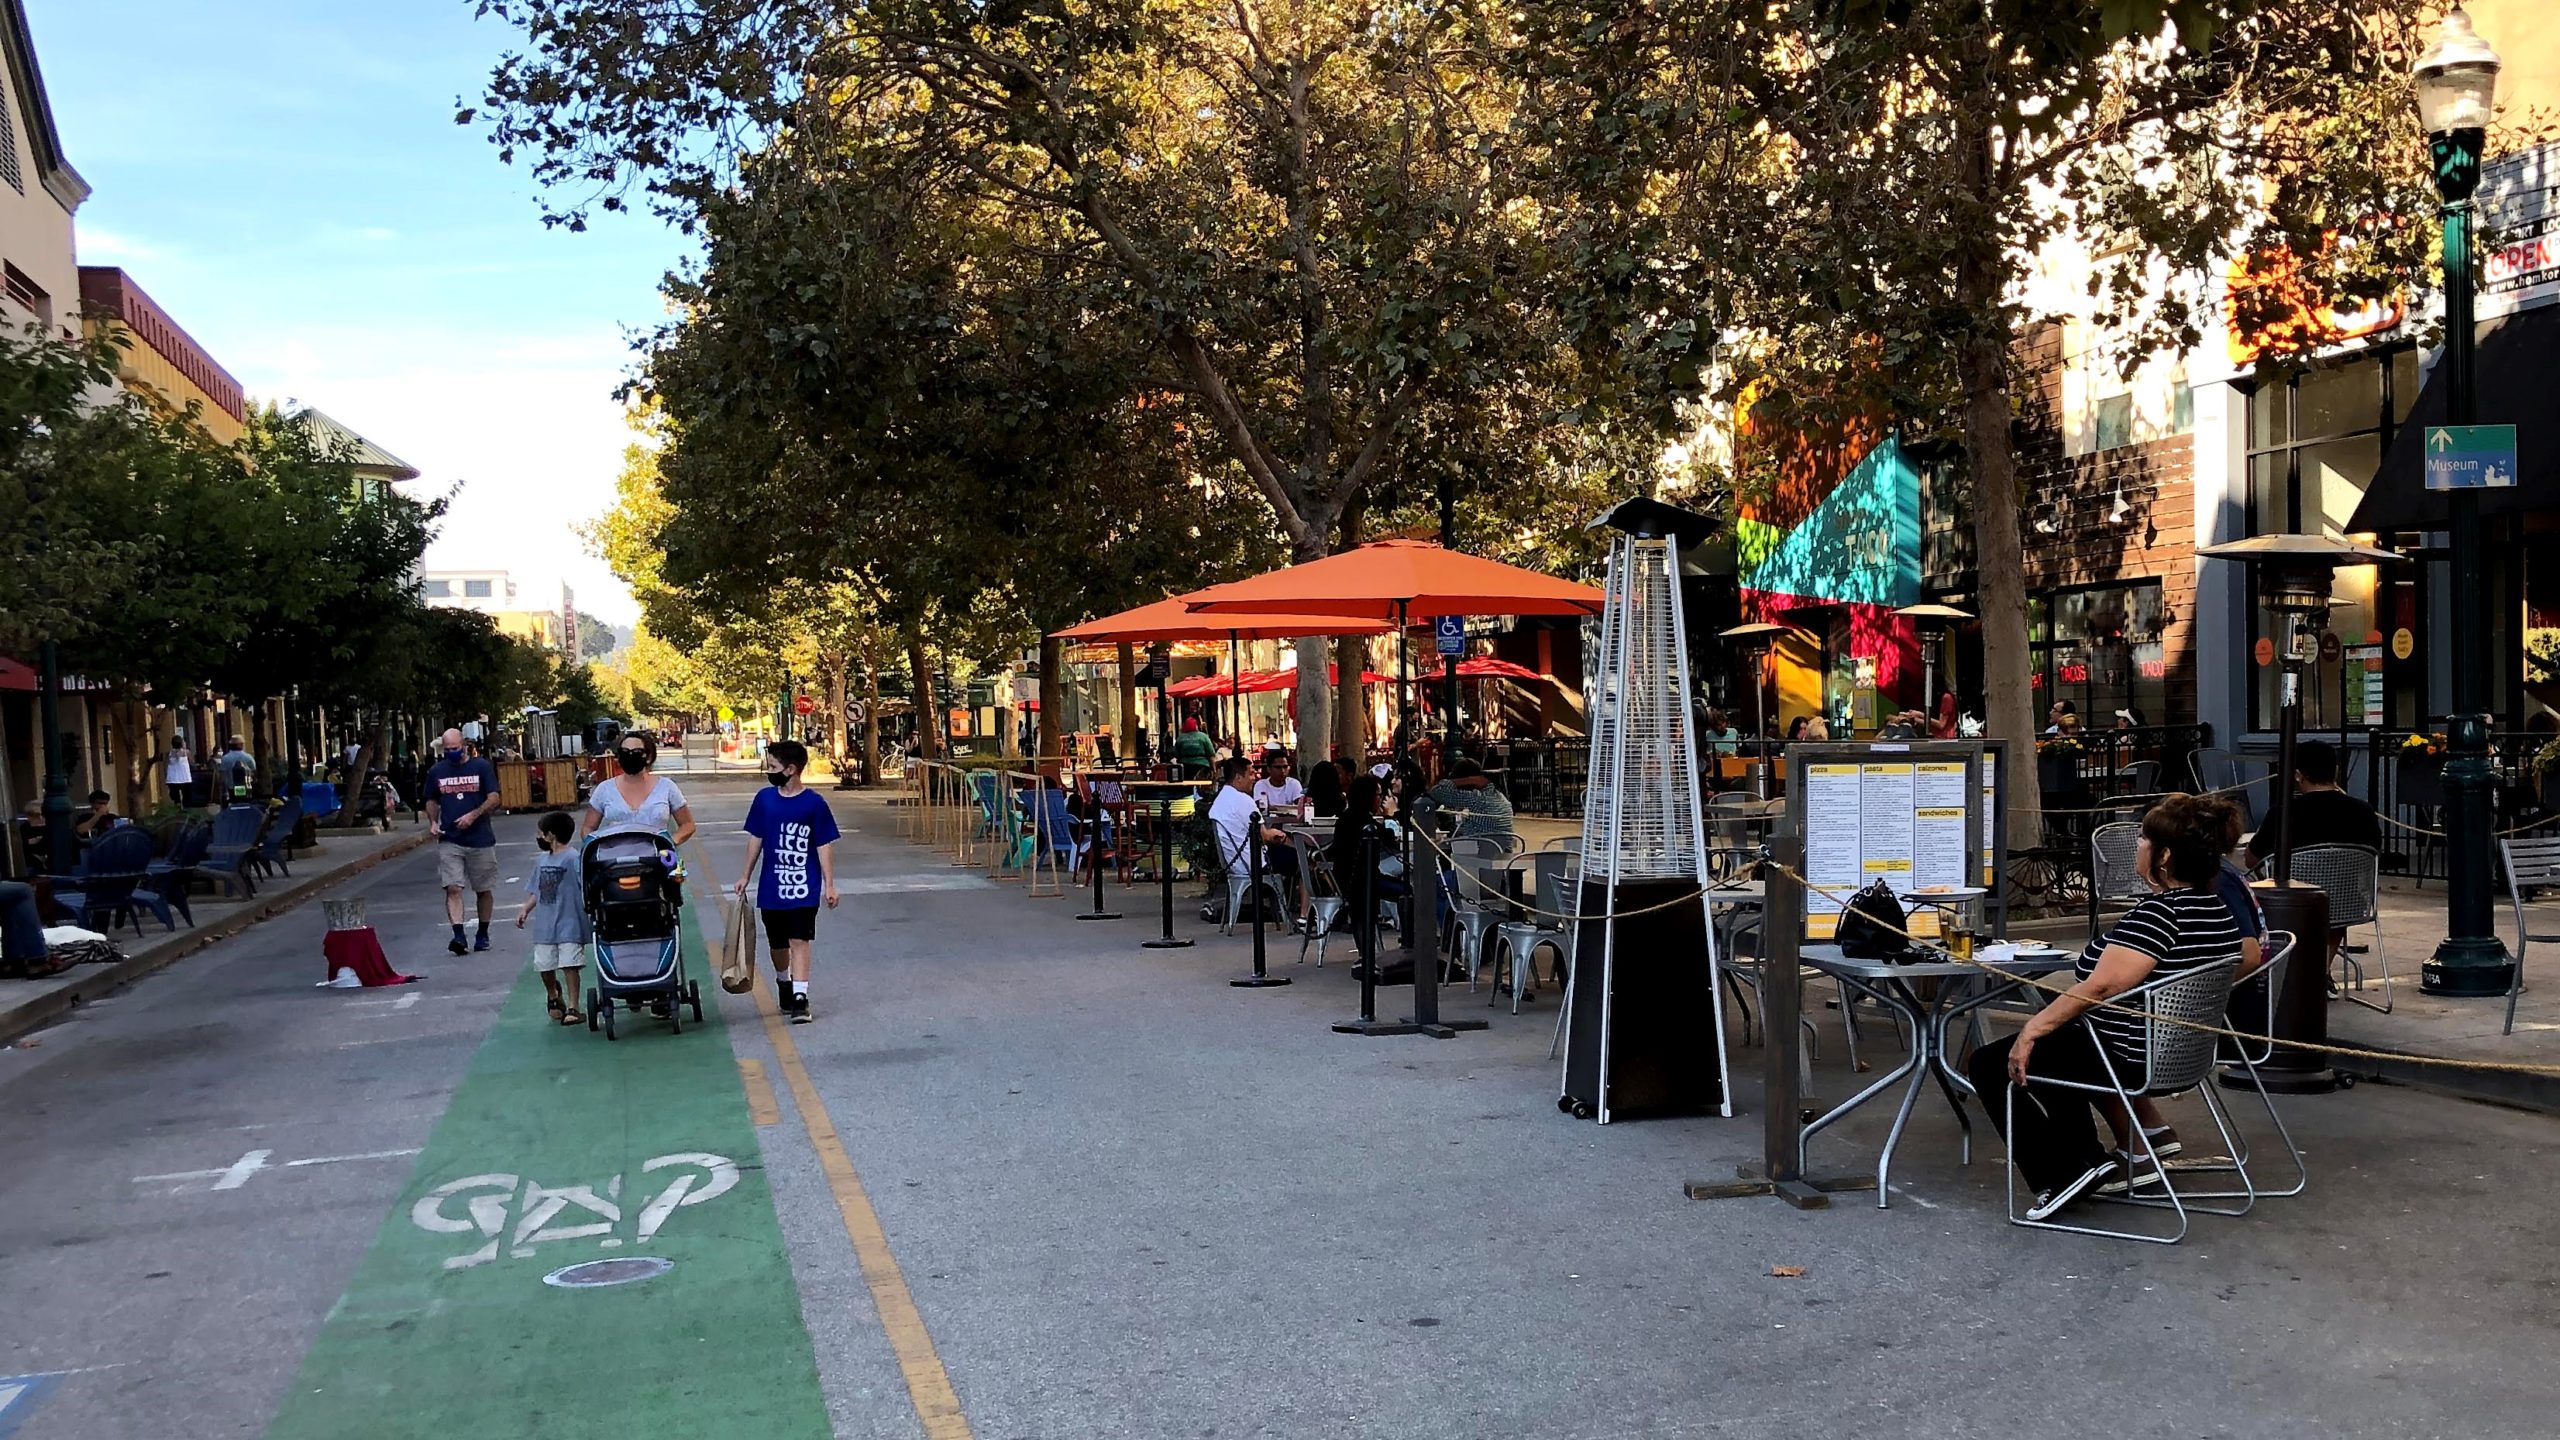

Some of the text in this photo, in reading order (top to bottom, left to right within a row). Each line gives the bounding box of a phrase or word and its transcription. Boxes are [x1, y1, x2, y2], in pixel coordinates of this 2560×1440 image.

[2491, 240, 2552, 276] OPEN
[2428, 459, 2478, 472] Museum
[1845, 527, 1888, 569] TACO
[2058, 665, 2086, 683] TACOS
[796, 701, 812, 709] STOP
[1810, 766, 1828, 774] pizza
[1864, 765, 1883, 773] pasta
[438, 775, 480, 786] WHEATON
